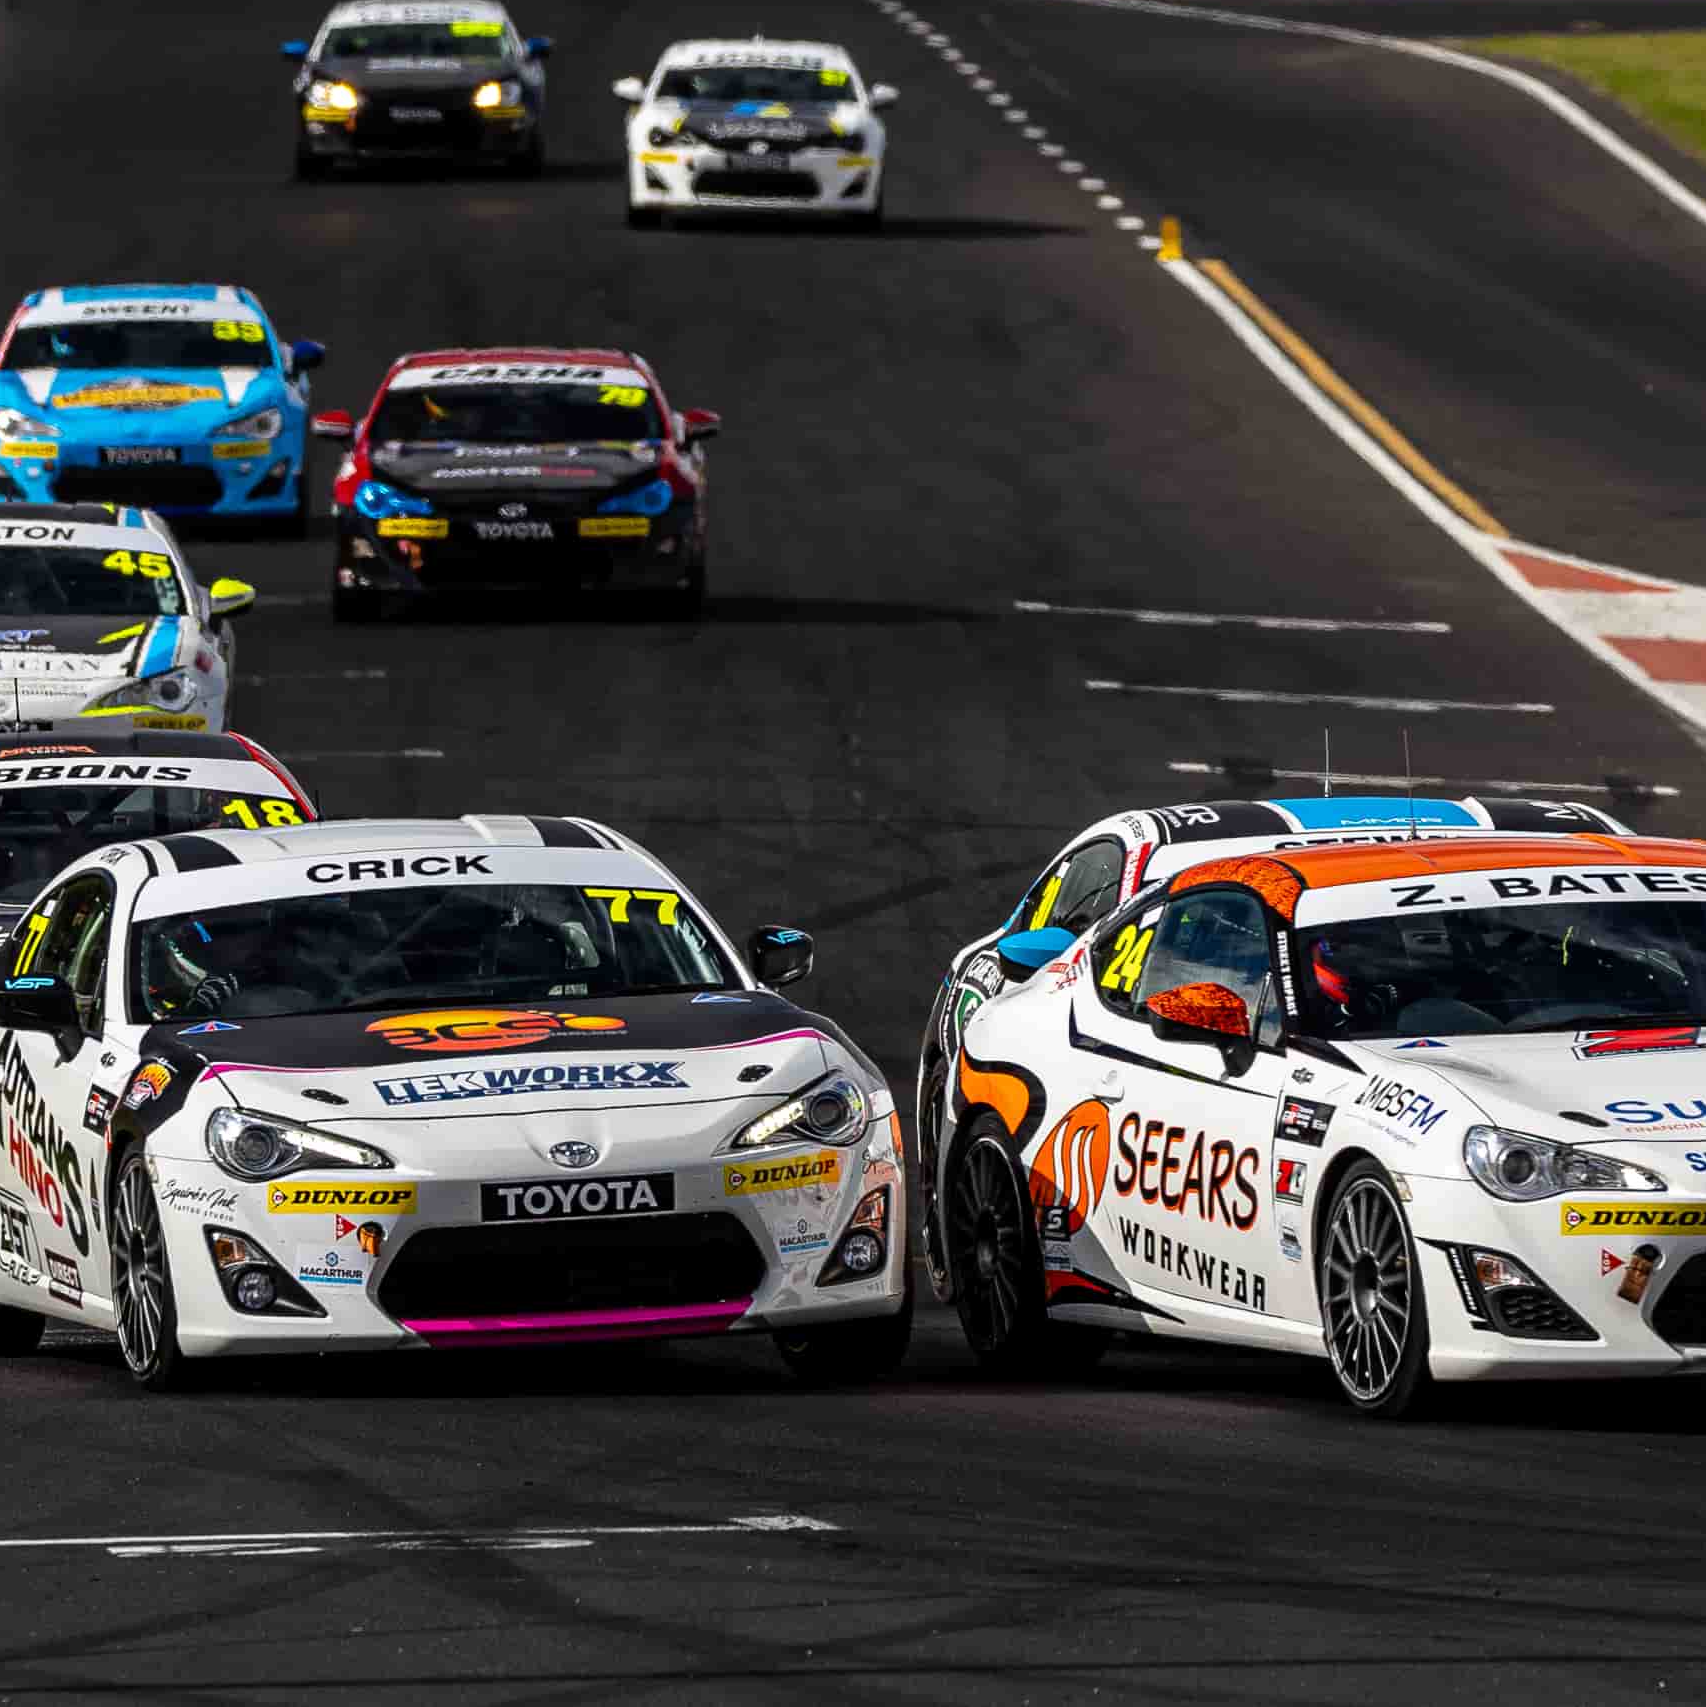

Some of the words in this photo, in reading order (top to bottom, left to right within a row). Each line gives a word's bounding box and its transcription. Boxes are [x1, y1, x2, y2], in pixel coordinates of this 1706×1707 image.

[101, 548, 171, 581] 45
[220, 797, 304, 831] 18
[305, 854, 494, 884] CRICK
[583, 887, 682, 926] 77
[1390, 883, 1466, 908] Z.
[1100, 923, 1155, 993] 24
[7, 1114, 64, 1229] HINO
[751, 1158, 836, 1185] DUNLOP
[1113, 1110, 1261, 1232] SEEARS
[291, 1189, 413, 1205] DUNLOP
[497, 1180, 658, 1217] TOYOTA
[299, 1265, 364, 1279] MACARTHUR
[1118, 1215, 1267, 1312] WORKWEAR
